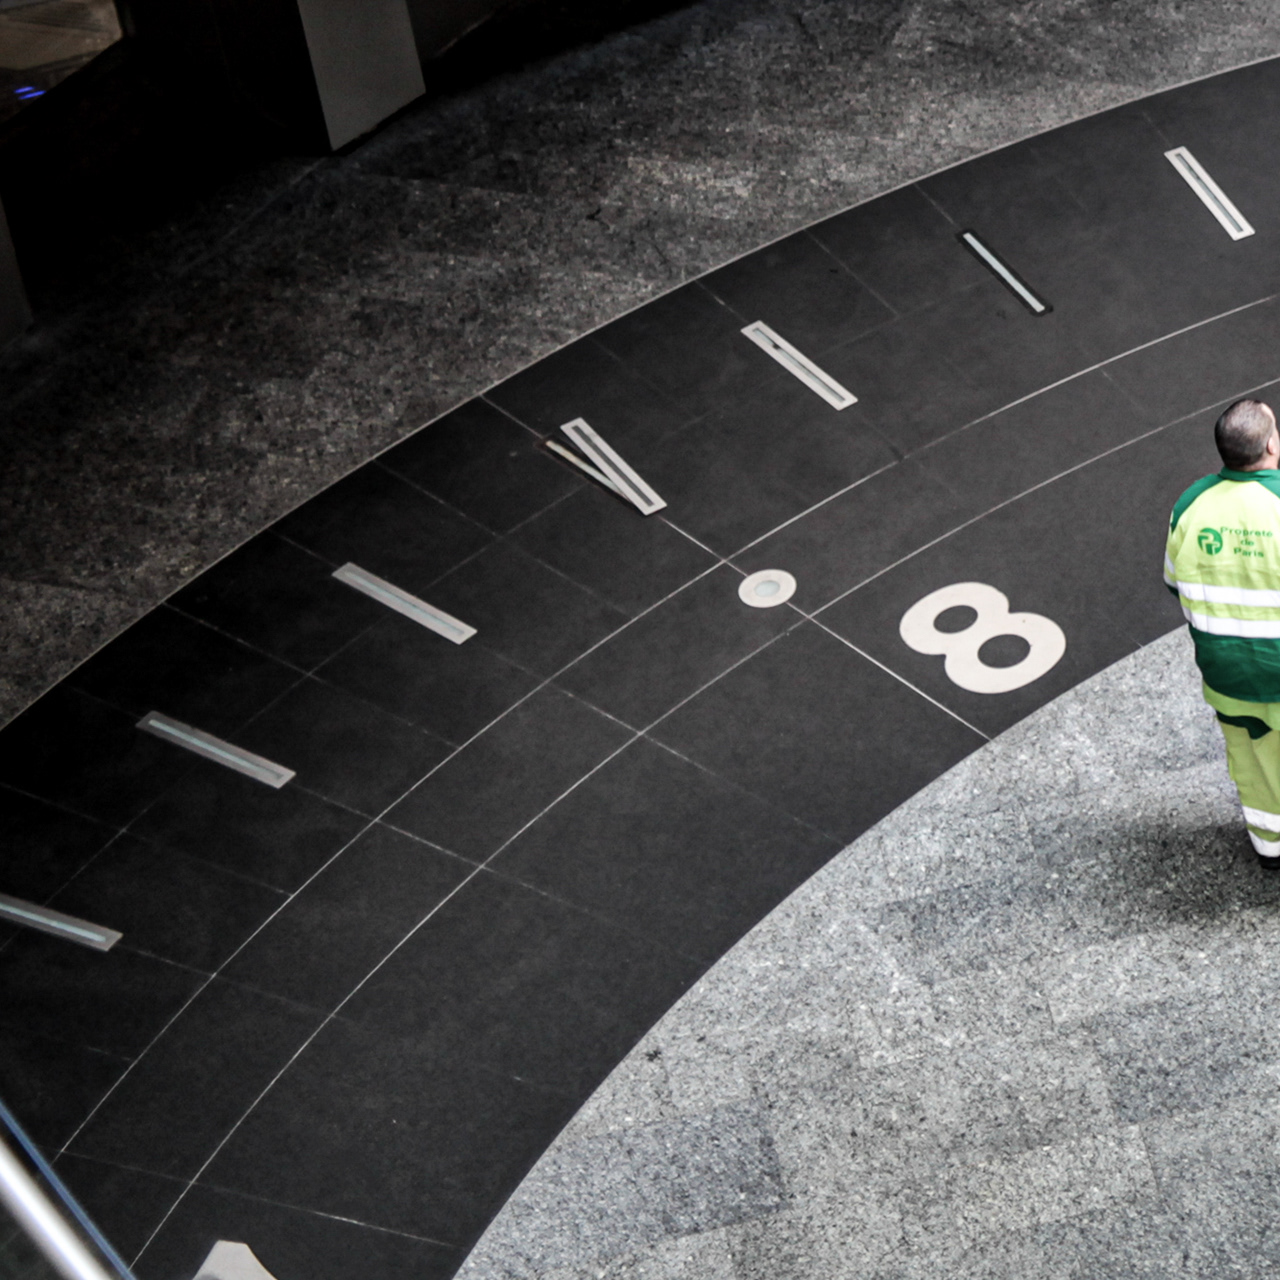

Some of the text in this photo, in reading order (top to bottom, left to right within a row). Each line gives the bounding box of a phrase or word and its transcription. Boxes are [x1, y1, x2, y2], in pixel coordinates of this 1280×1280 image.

[1220, 526, 1274, 538] Propreté
[1233, 547, 1265, 558] Paris
[899, 581, 1067, 694] 8
